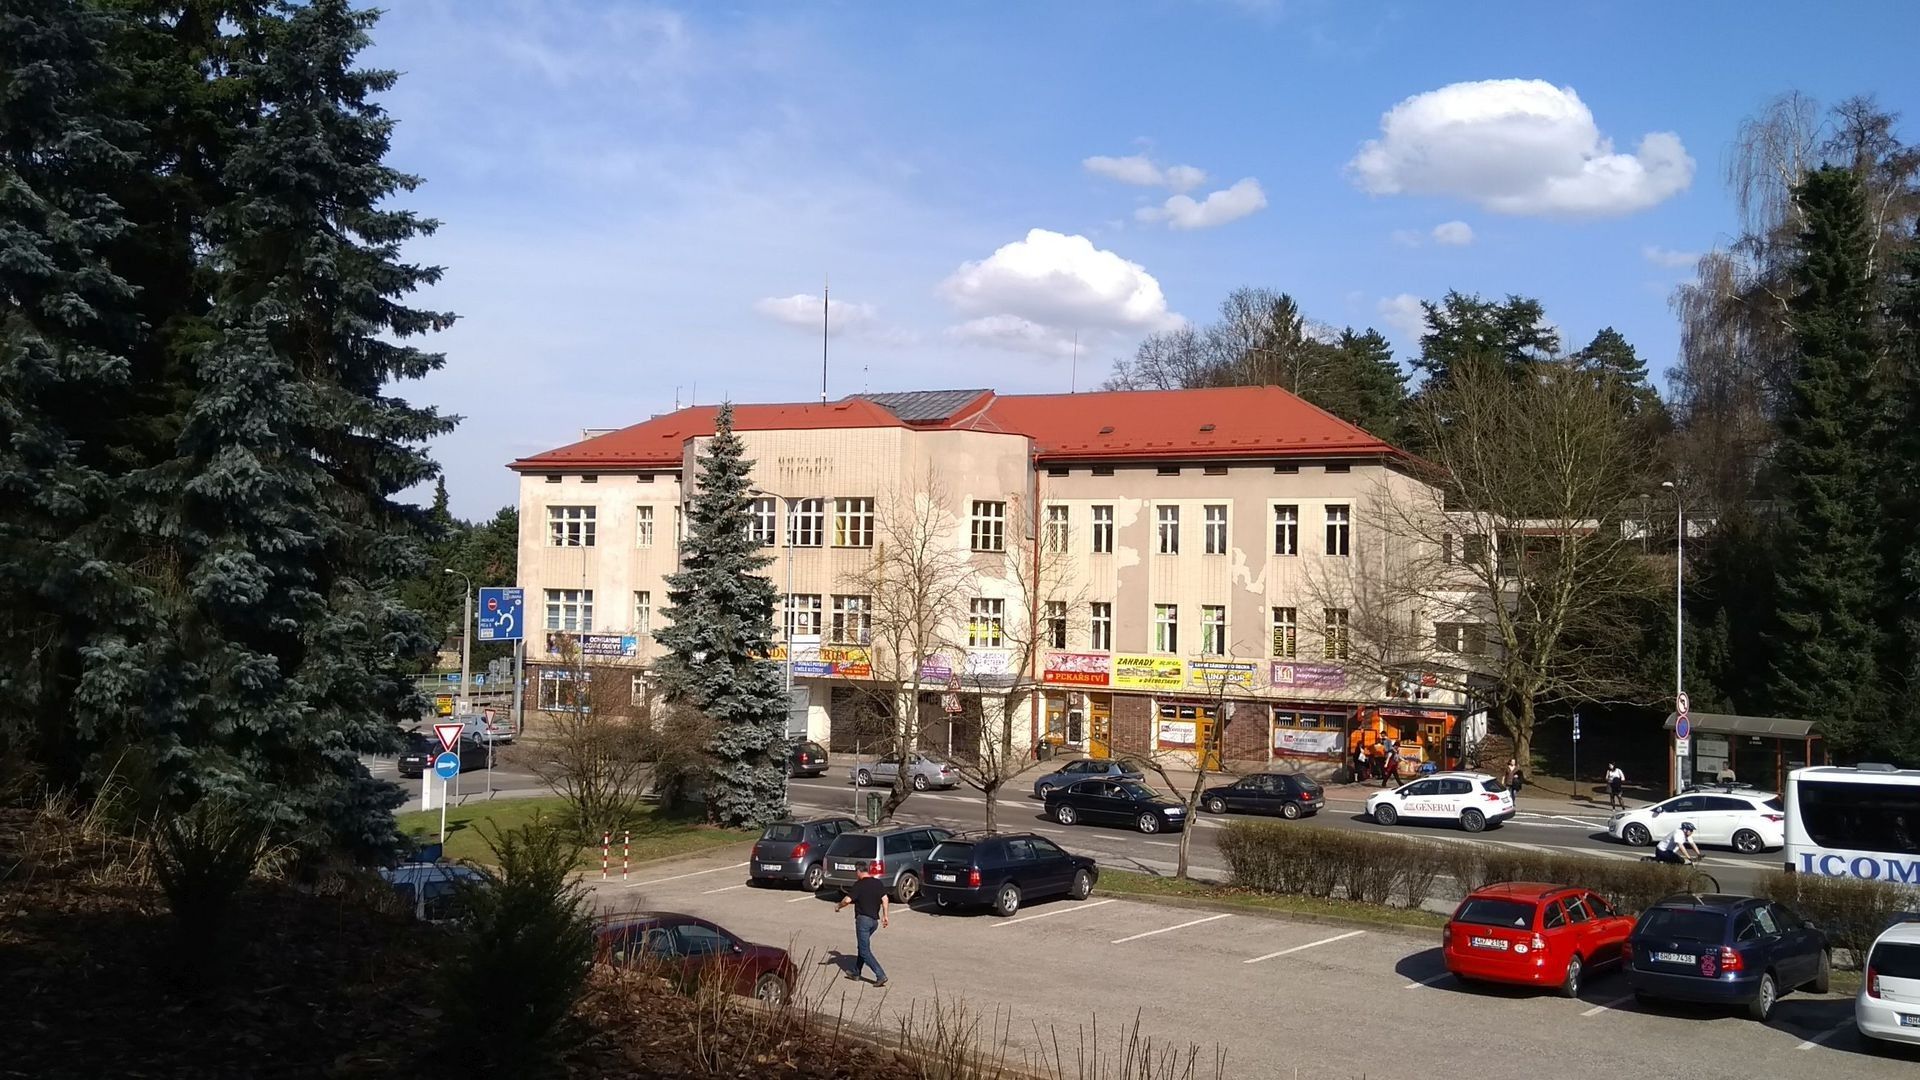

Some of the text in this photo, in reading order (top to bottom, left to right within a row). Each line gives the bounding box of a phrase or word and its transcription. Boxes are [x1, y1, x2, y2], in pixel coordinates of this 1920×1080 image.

[1274, 627, 1283, 656] STUDIO
[1117, 657, 1155, 667] ZAHRADY
[1415, 803, 1456, 812] GENERALI
[1800, 852, 1920, 884] ICOM
